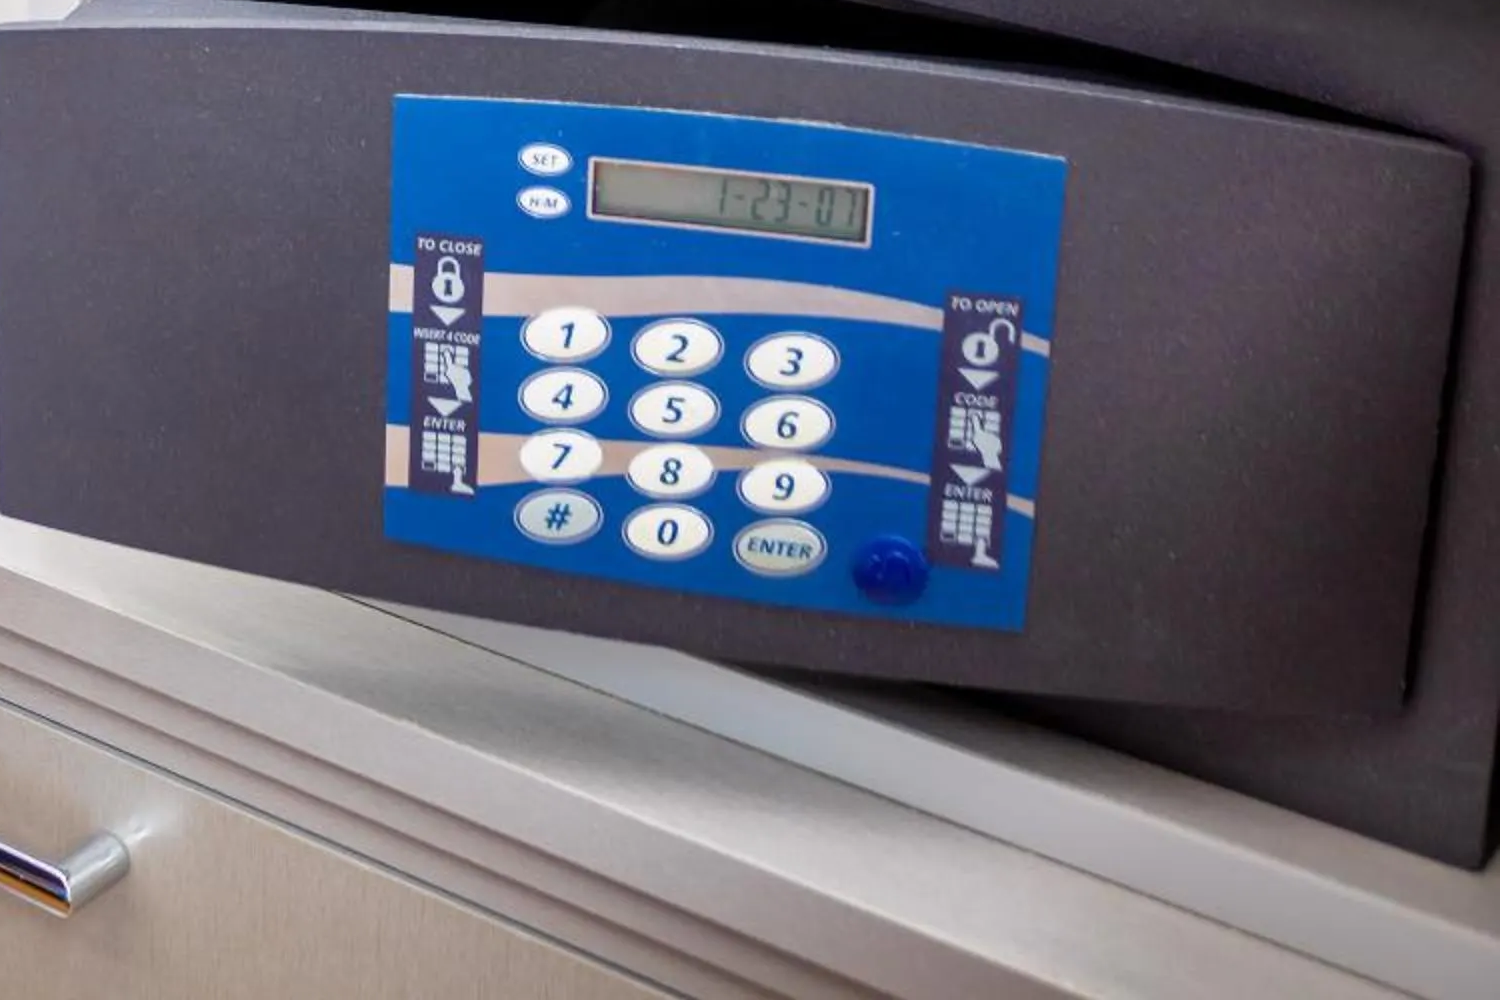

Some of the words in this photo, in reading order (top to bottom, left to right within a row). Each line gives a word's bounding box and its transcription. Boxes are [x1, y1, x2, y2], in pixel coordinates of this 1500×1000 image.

[531, 152, 558, 169] SET
[417, 236, 436, 251] TO
[439, 239, 483, 256] CLOSE
[951, 295, 972, 312] TO
[975, 298, 1020, 317] OPEN
[453, 331, 482, 345] CODE
[560, 322, 575, 349] 1
[665, 334, 689, 363] 2
[779, 347, 803, 376] 3
[552, 383, 574, 410] 4
[662, 397, 685, 423] 5
[954, 391, 998, 409] CODE
[423, 416, 466, 433] ENTER
[777, 411, 799, 439] 6
[550, 443, 573, 470] 7
[659, 457, 682, 485] 8
[772, 472, 795, 500] 9
[944, 483, 993, 503] ENTER
[545, 502, 572, 531] #
[656, 519, 679, 546] 0
[747, 535, 815, 561] ENTER
